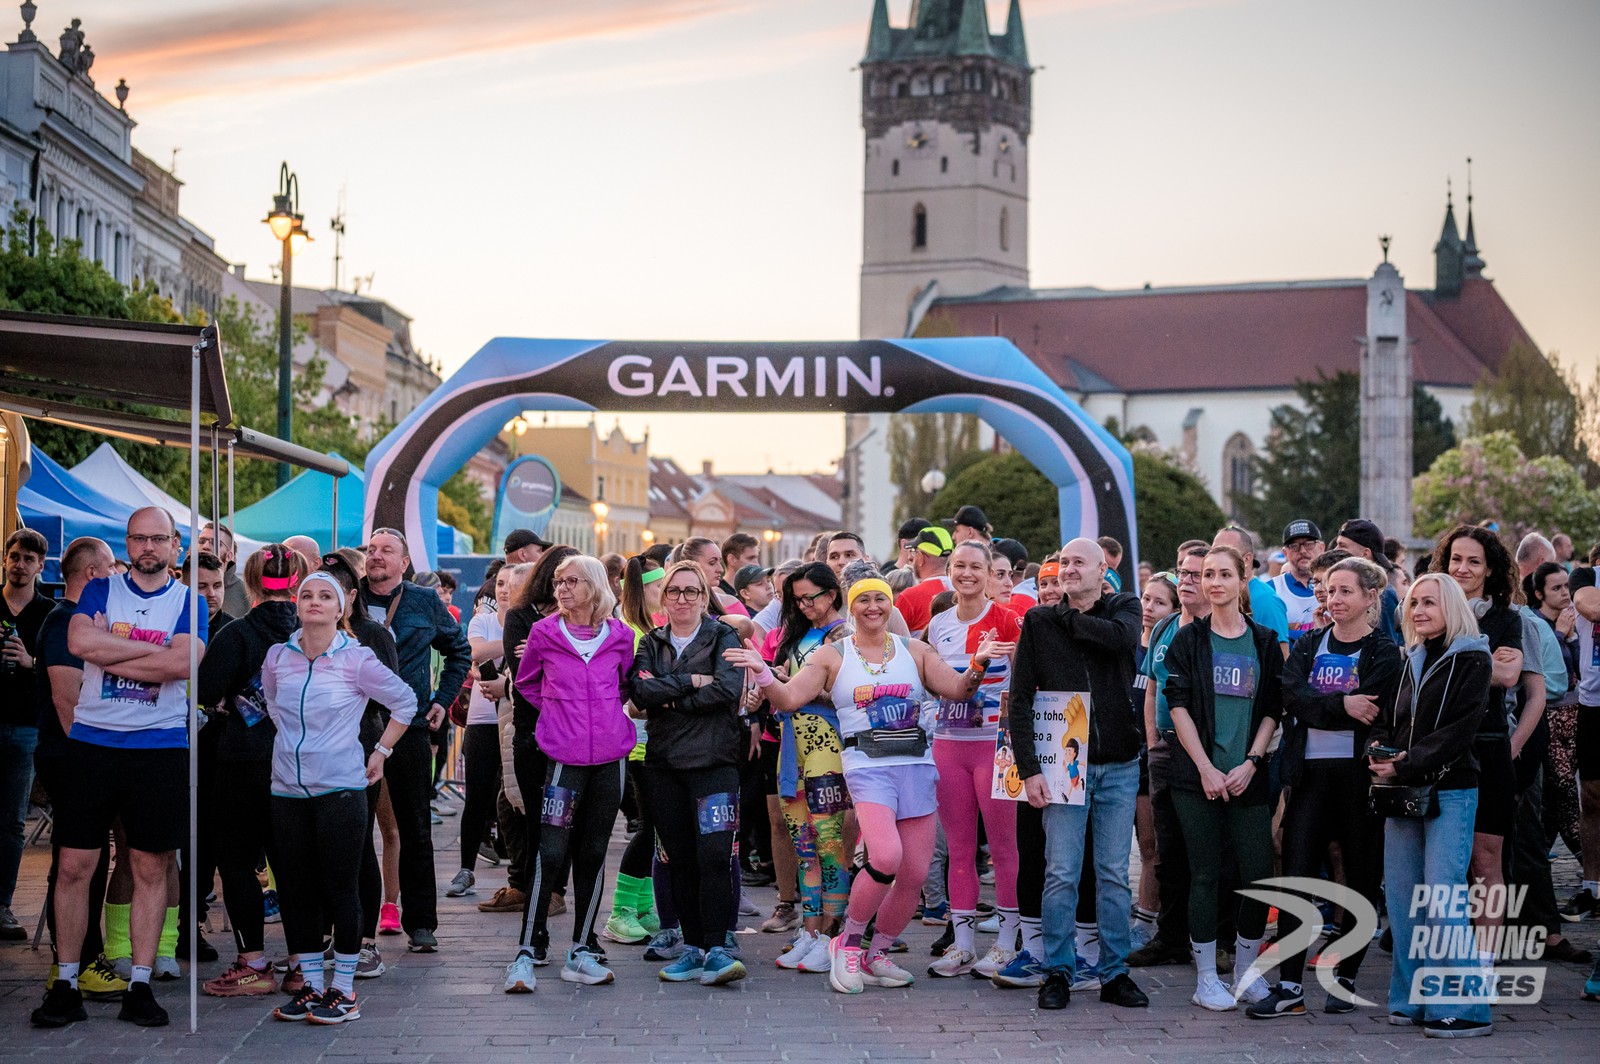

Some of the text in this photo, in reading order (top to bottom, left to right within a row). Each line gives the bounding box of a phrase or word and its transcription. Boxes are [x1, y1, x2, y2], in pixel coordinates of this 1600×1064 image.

[607, 354, 882, 397] GARMIN
[1213, 665, 1241, 687] 630
[1316, 666, 1344, 685] 482
[882, 703, 907, 723] 1017
[948, 702, 969, 720] 201
[1043, 709, 1066, 724] toho,
[1046, 732, 1052, 742] a
[816, 785, 842, 805] 395
[541, 797, 565, 817] 368
[711, 804, 736, 823] 393
[237, 974, 259, 986] HOKA
